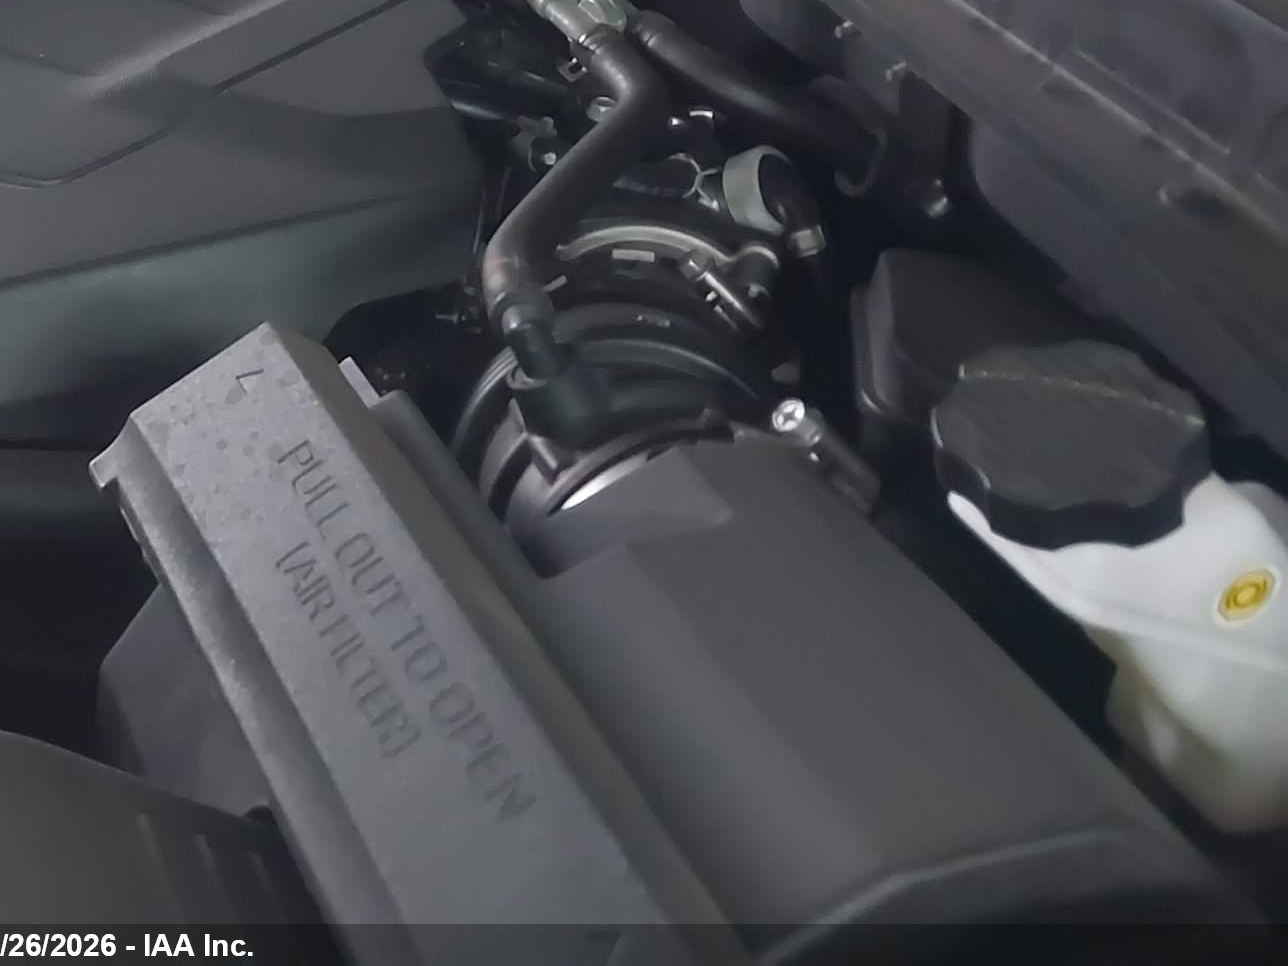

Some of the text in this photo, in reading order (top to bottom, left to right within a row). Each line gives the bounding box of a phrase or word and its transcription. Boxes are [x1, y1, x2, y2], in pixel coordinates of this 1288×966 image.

[276, 438, 539, 824] PULL OUT TO OPEN
[276, 540, 422, 760] (AIR FILTER)
